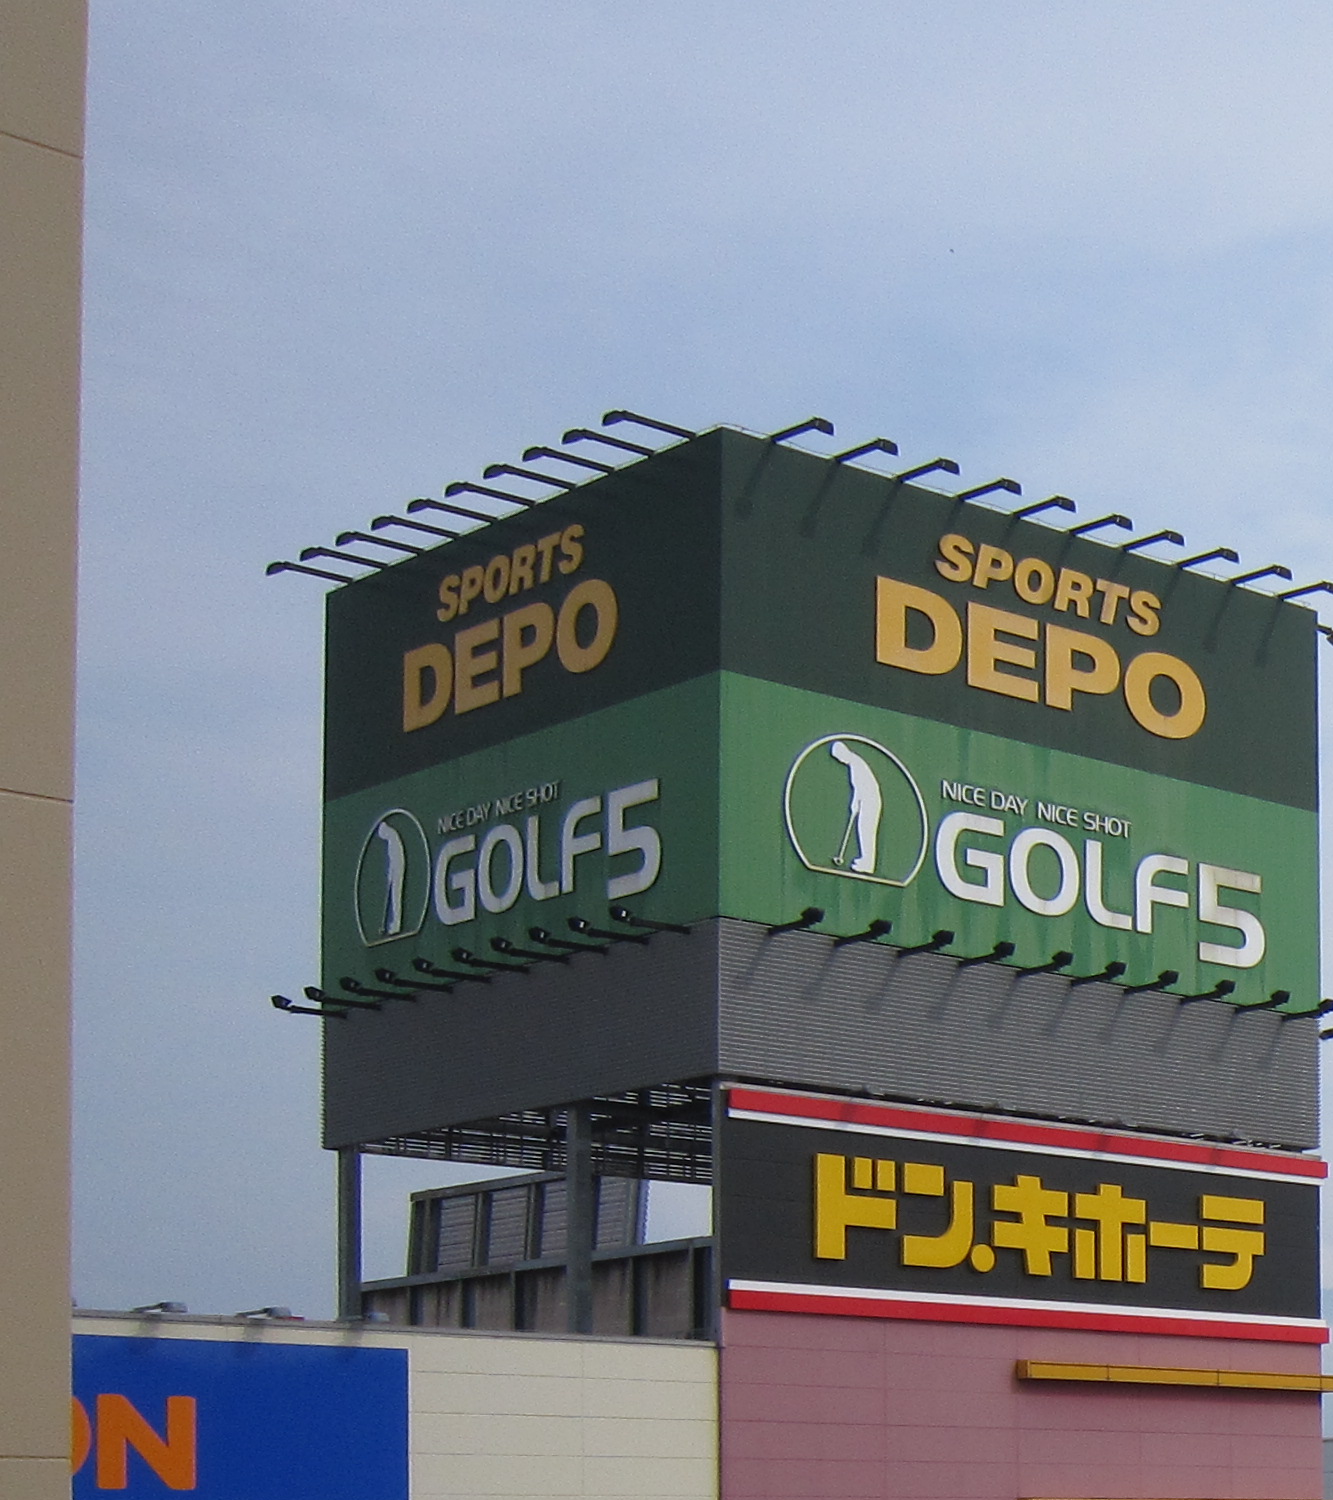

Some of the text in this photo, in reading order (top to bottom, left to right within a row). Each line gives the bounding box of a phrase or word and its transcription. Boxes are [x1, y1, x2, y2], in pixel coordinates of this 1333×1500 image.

[436, 524, 585, 623] SPORTS
[936, 533, 1163, 637] SPORTS
[403, 578, 619, 733] DEPO
[876, 575, 1206, 741] DEPO
[434, 778, 661, 927] GOLF5
[437, 781, 561, 834] NICE DAY NICE SHOT
[941, 779, 1132, 838] NICE DAY NICE SHOT
[935, 812, 1267, 969] GOLF5
